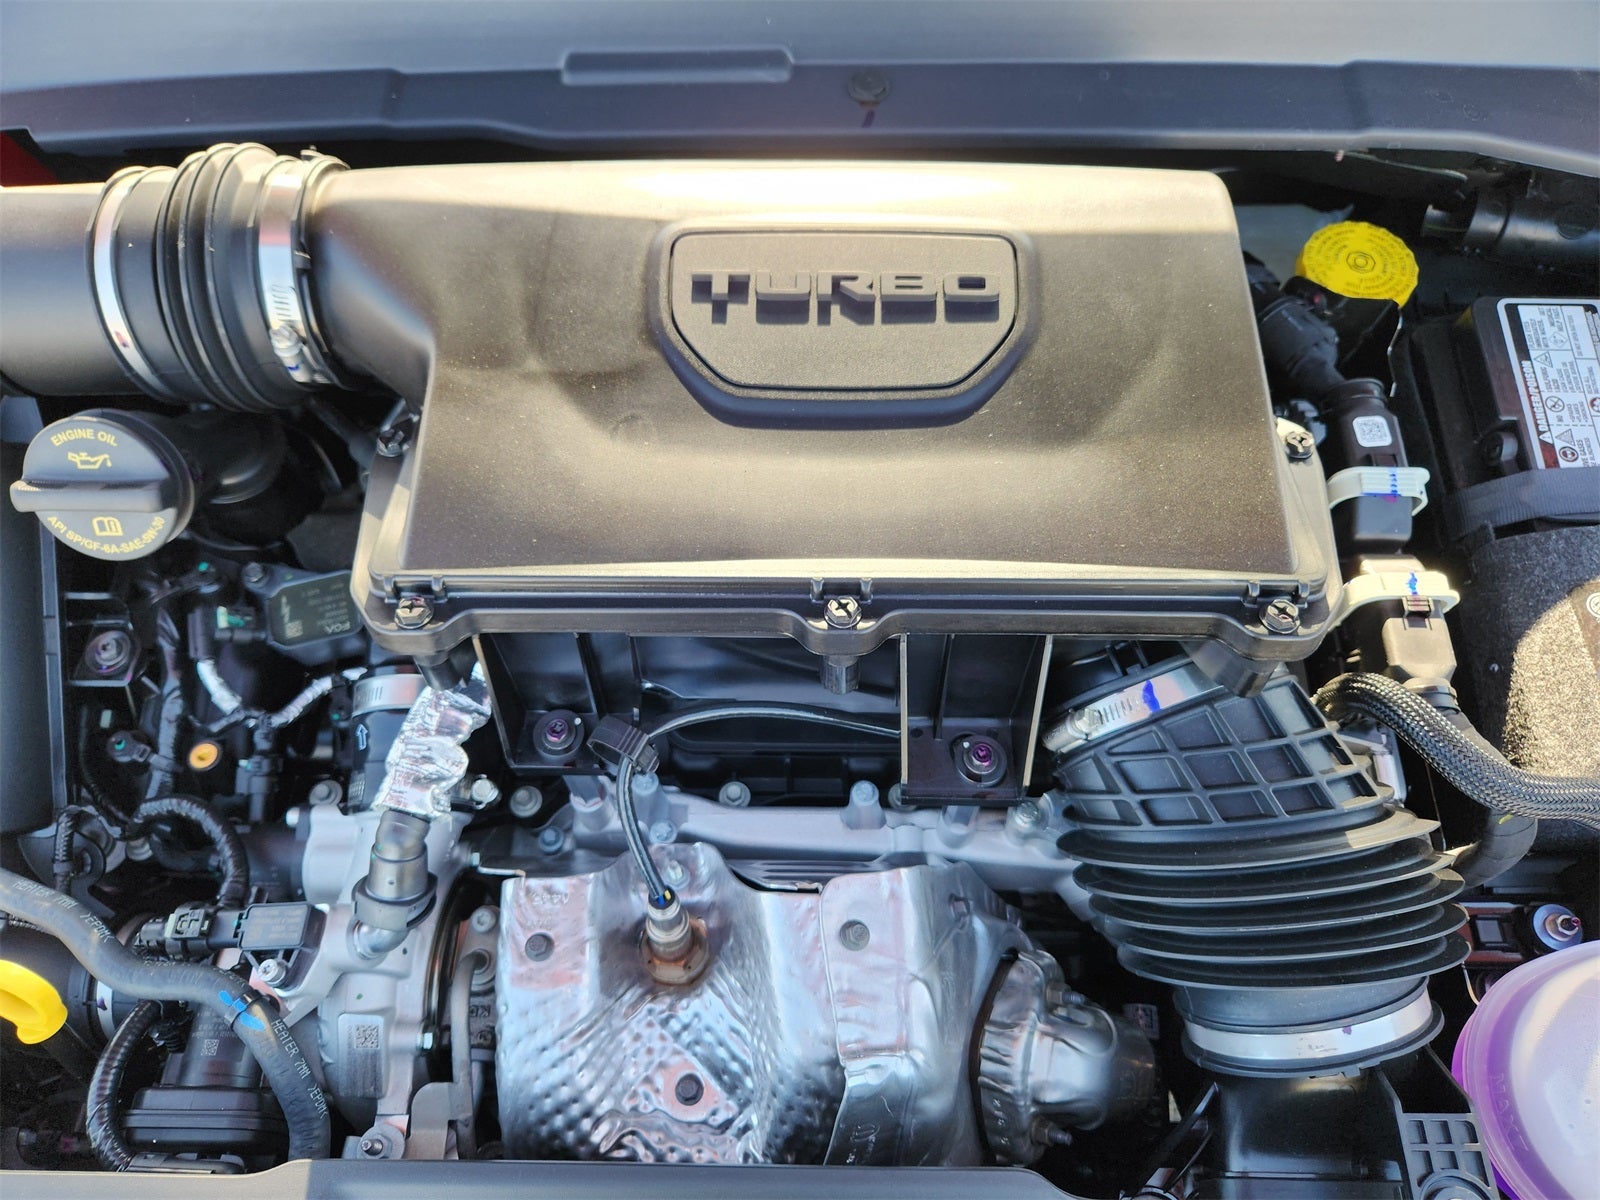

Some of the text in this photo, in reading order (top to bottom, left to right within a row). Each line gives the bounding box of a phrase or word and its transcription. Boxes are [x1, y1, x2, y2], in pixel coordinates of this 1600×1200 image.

[690, 269, 1001, 315] TURBO
[1521, 361, 1549, 431] DANGER/POISON
[50, 428, 118, 447] ENGINE OIL
[47, 516, 66, 533] API
[12, 880, 55, 898] HEATER
[271, 1019, 300, 1058] HEATER
[294, 1058, 311, 1080] 7MM
